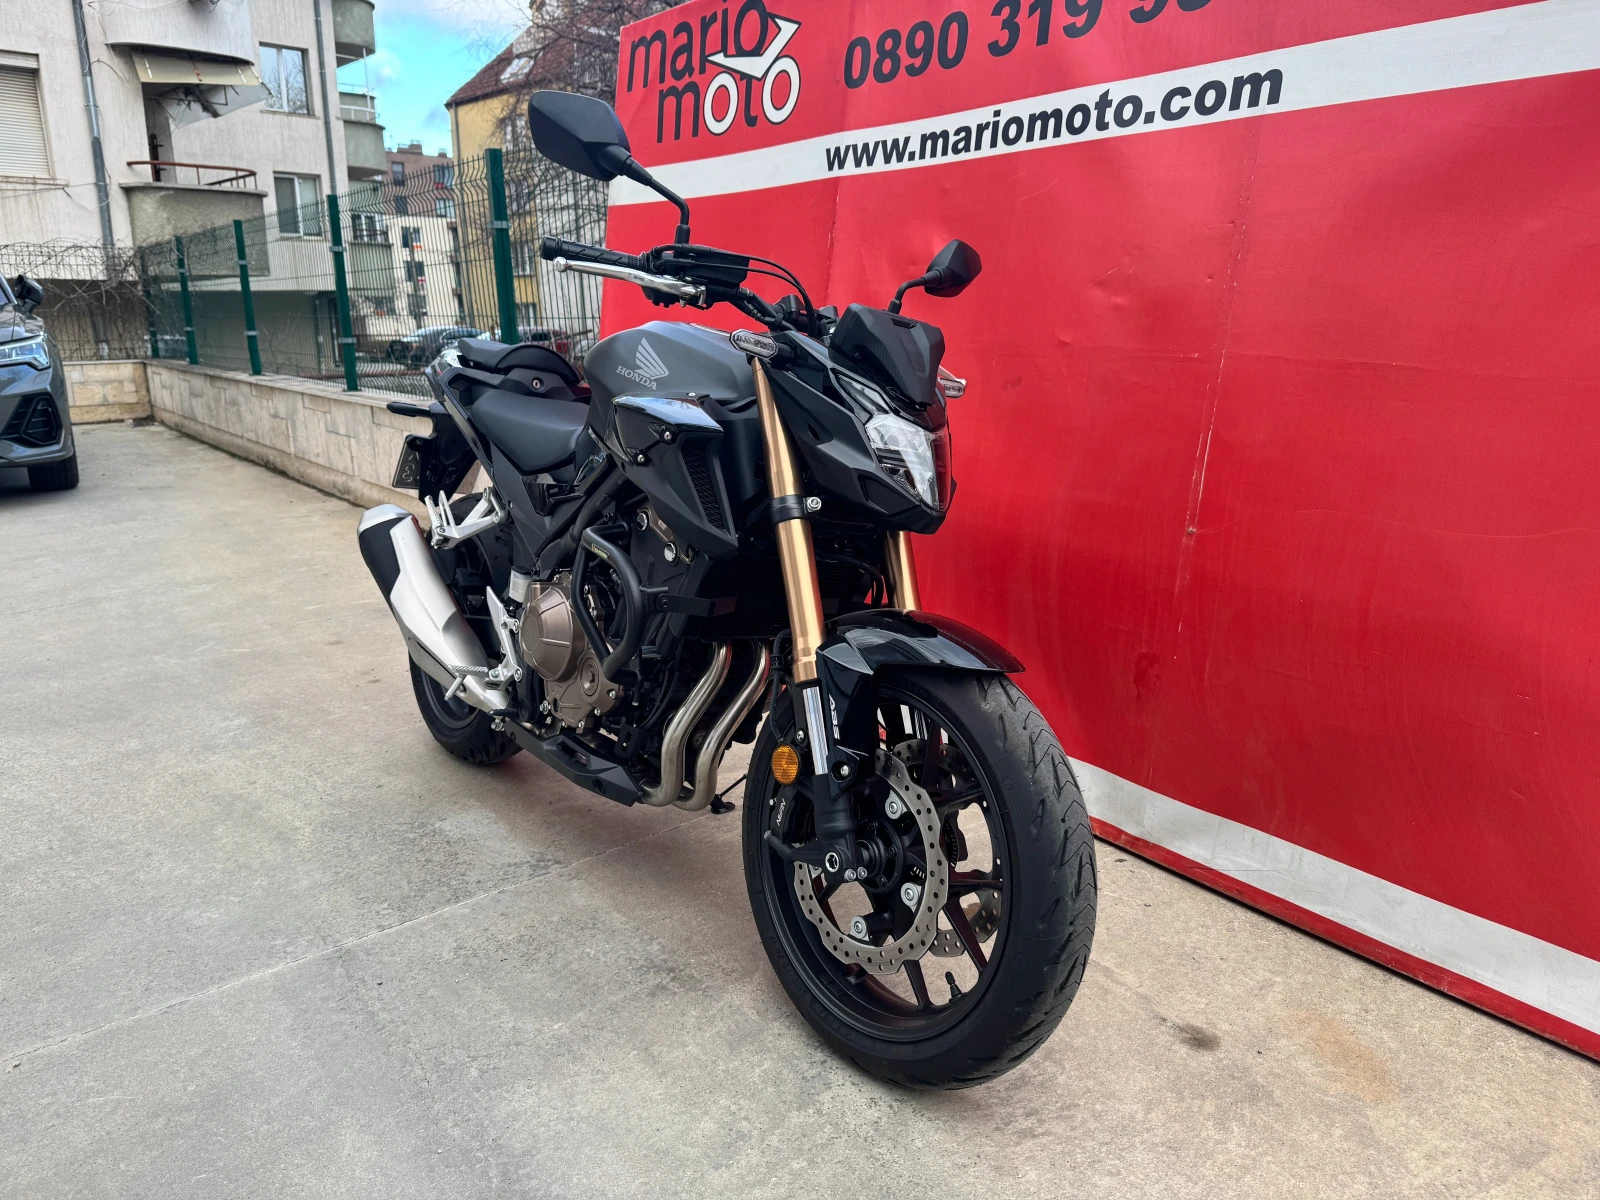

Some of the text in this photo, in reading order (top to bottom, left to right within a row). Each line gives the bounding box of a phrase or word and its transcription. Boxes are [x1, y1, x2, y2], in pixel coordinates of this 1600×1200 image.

[627, 0, 768, 92] mario
[843, 0, 1102, 89] 0890 319
[657, 55, 801, 143] moto
[825, 68, 1284, 172] www.mariomoto.com
[616, 365, 657, 390] HONDA
[829, 693, 840, 740] ABS
